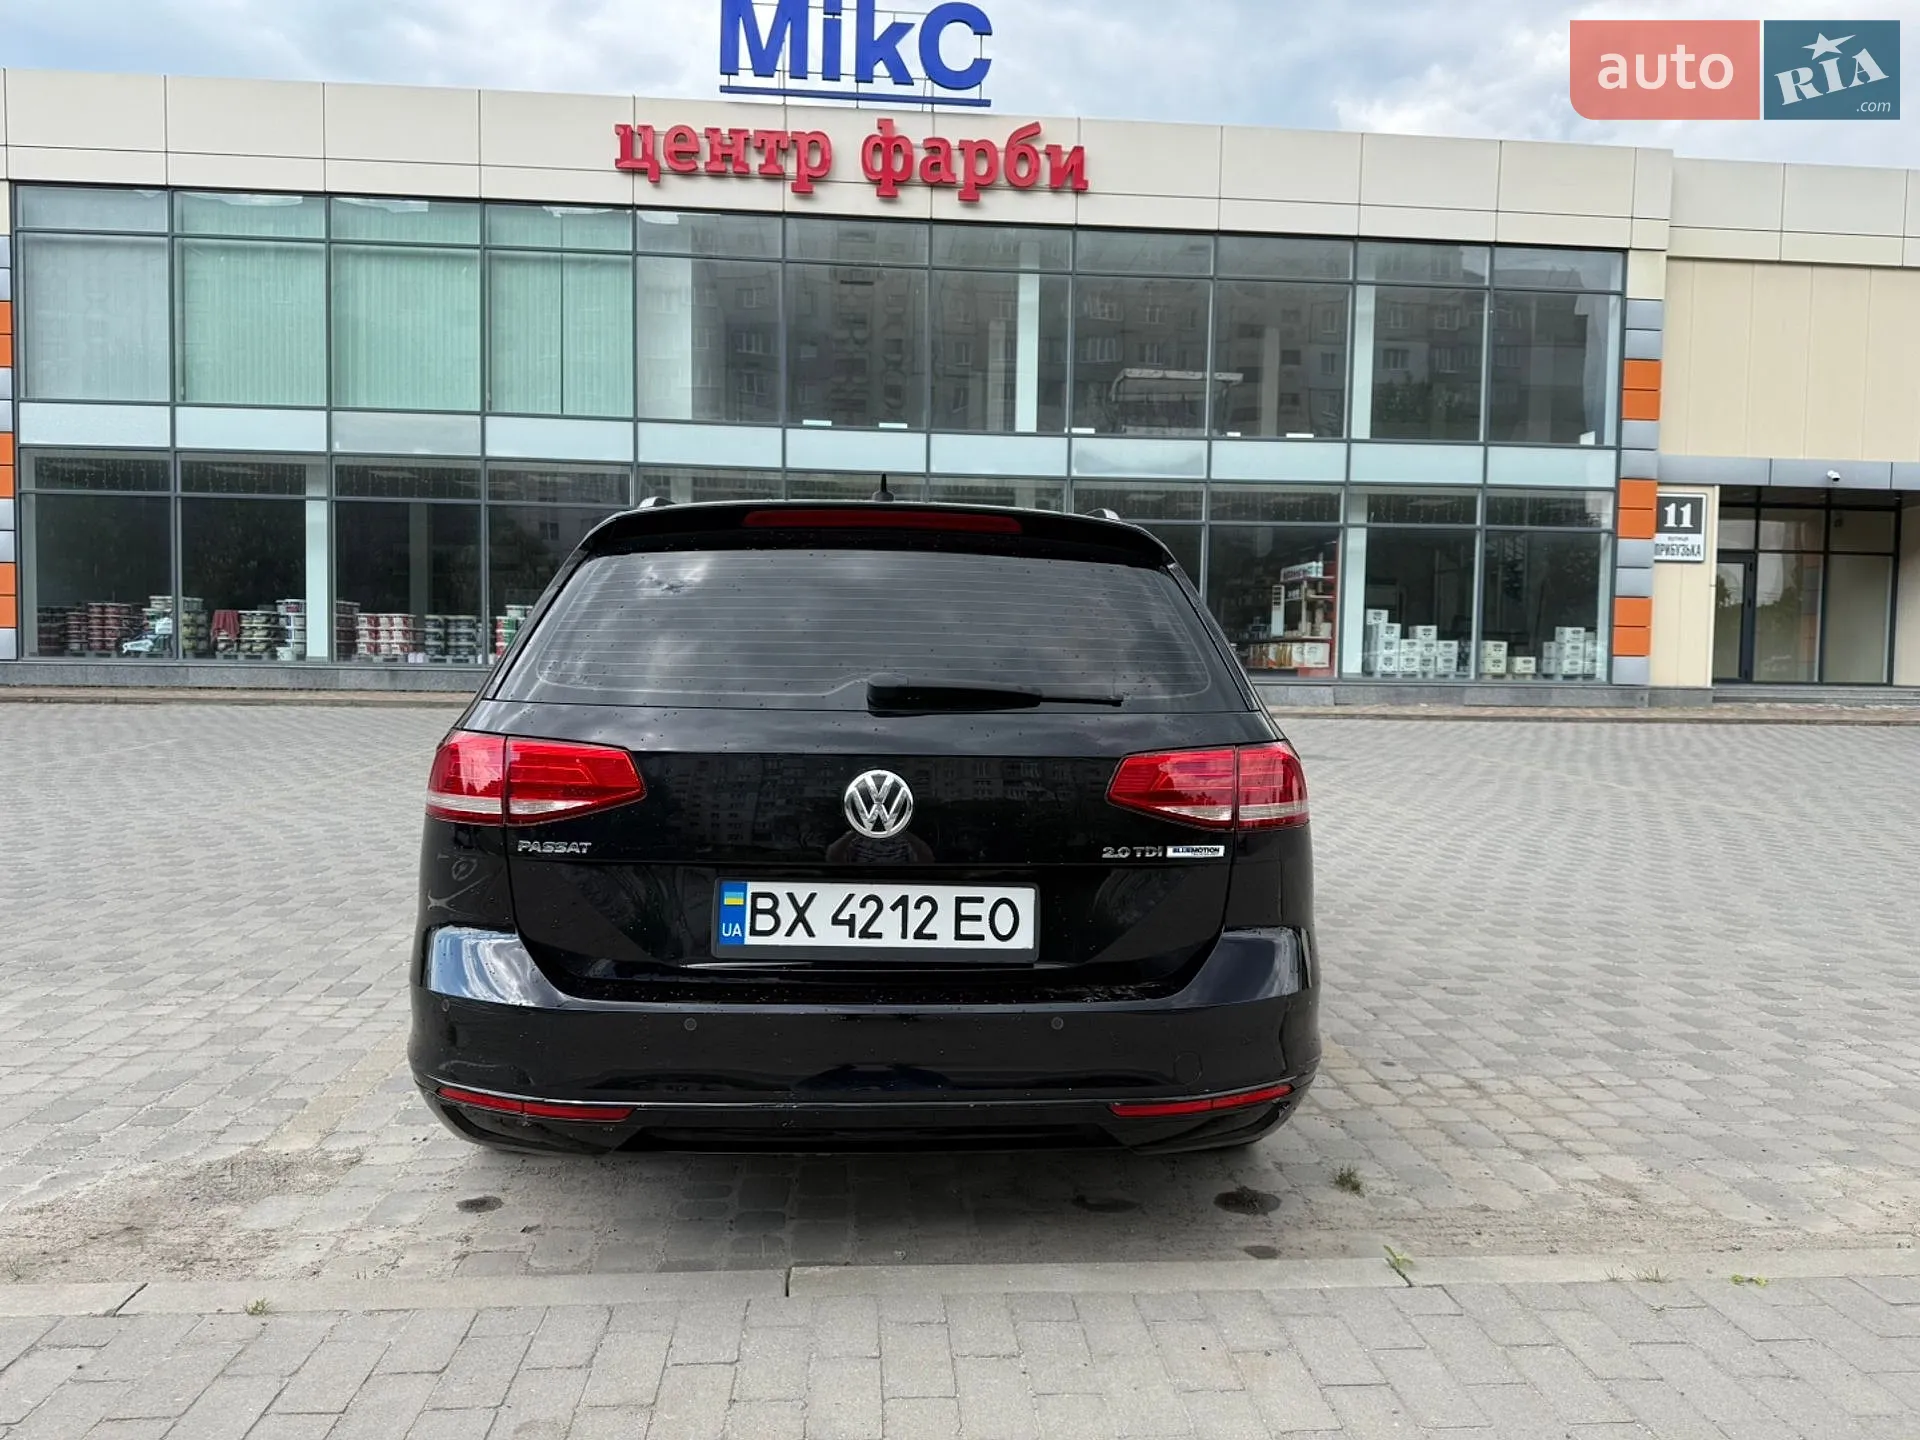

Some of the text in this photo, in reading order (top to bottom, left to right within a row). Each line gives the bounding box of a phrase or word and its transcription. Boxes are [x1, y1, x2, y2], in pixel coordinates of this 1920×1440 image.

[614, 118, 1089, 202] центр фарби
[1663, 502, 1695, 528] 11
[517, 839, 593, 854] PASSAT
[1102, 845, 1164, 859] 2.0 TDI
[750, 891, 818, 938] BX
[831, 892, 939, 940] 4212
[722, 922, 742, 937] UA
